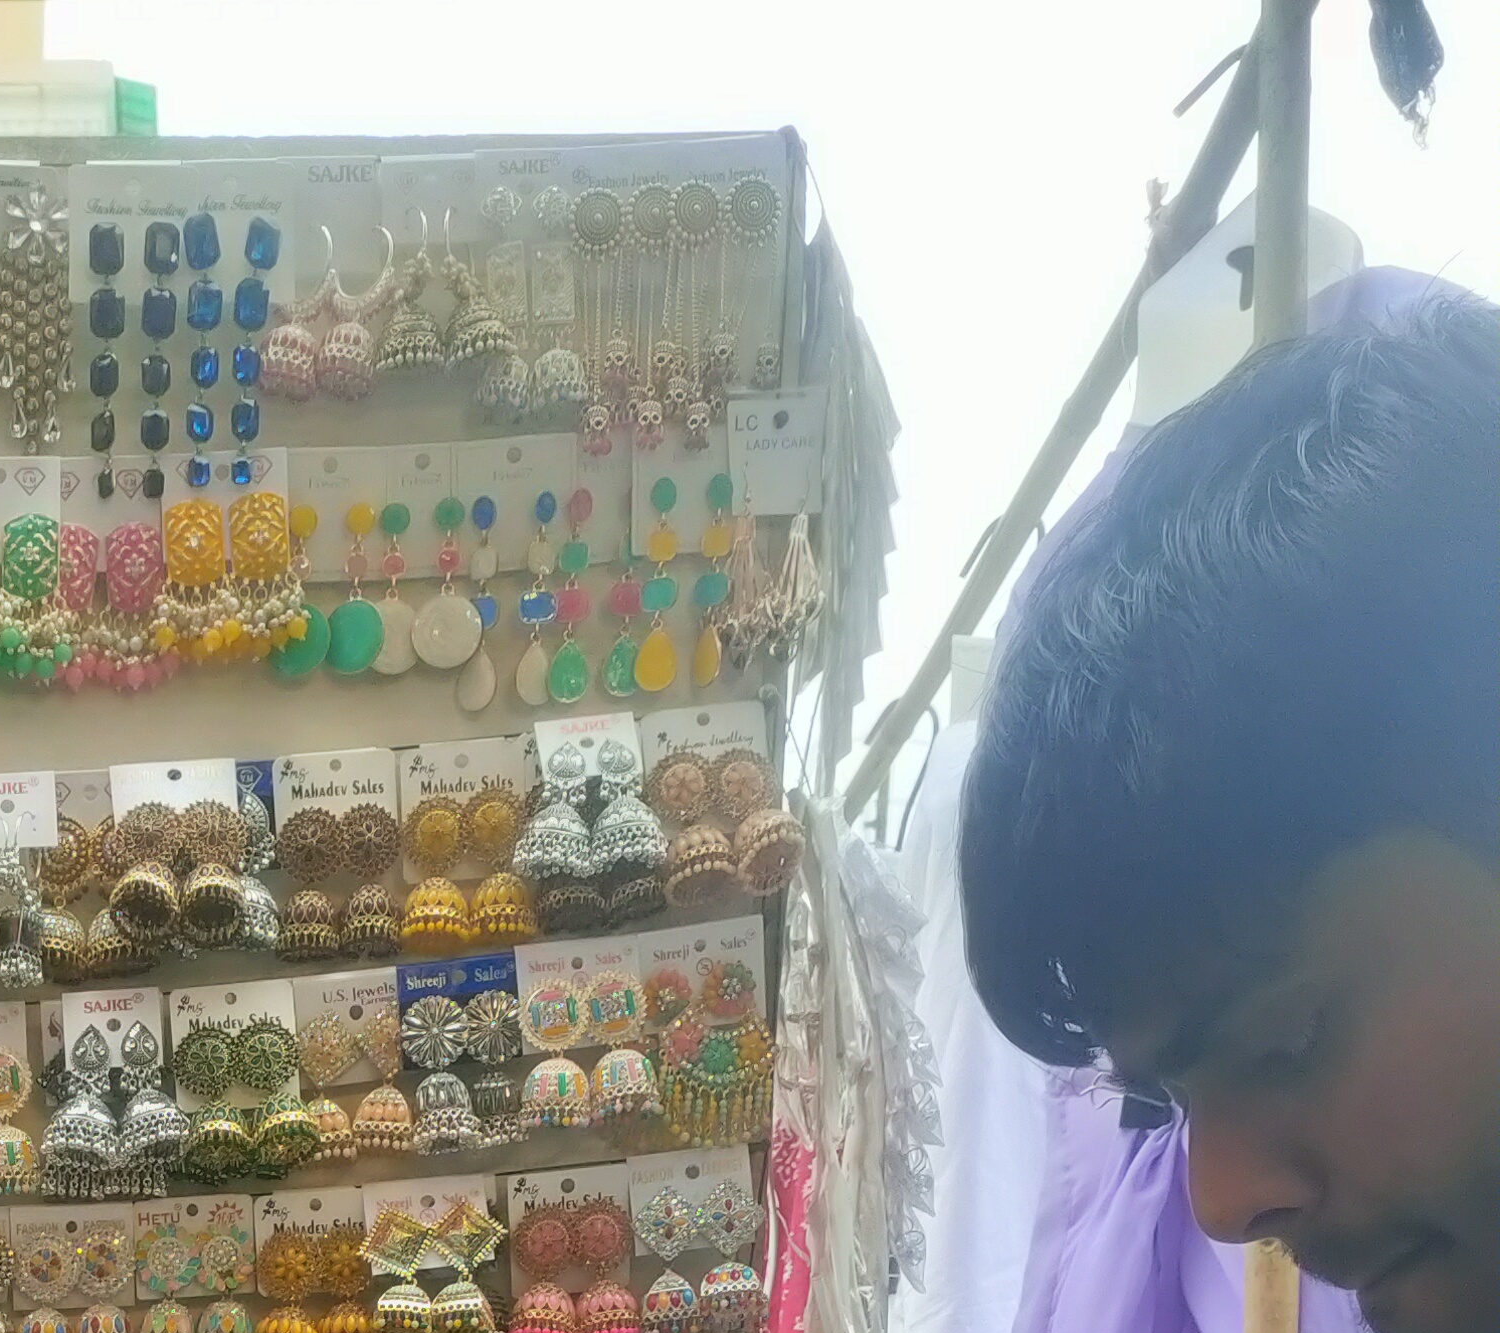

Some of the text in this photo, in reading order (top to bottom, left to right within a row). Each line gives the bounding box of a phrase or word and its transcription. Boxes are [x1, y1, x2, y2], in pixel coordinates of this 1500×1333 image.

[735, 415, 758, 431] LC
[291, 780, 384, 800] Mahadev Sales
[420, 775, 514, 796] Mahadev Sales
[653, 936, 747, 963] Shreeji Sales
[527, 952, 623, 976] Shreeji Sales
[406, 967, 508, 991] Shreeji Sales
[352, 982, 396, 1002] Jewels
[138, 1211, 181, 1227] HETU
